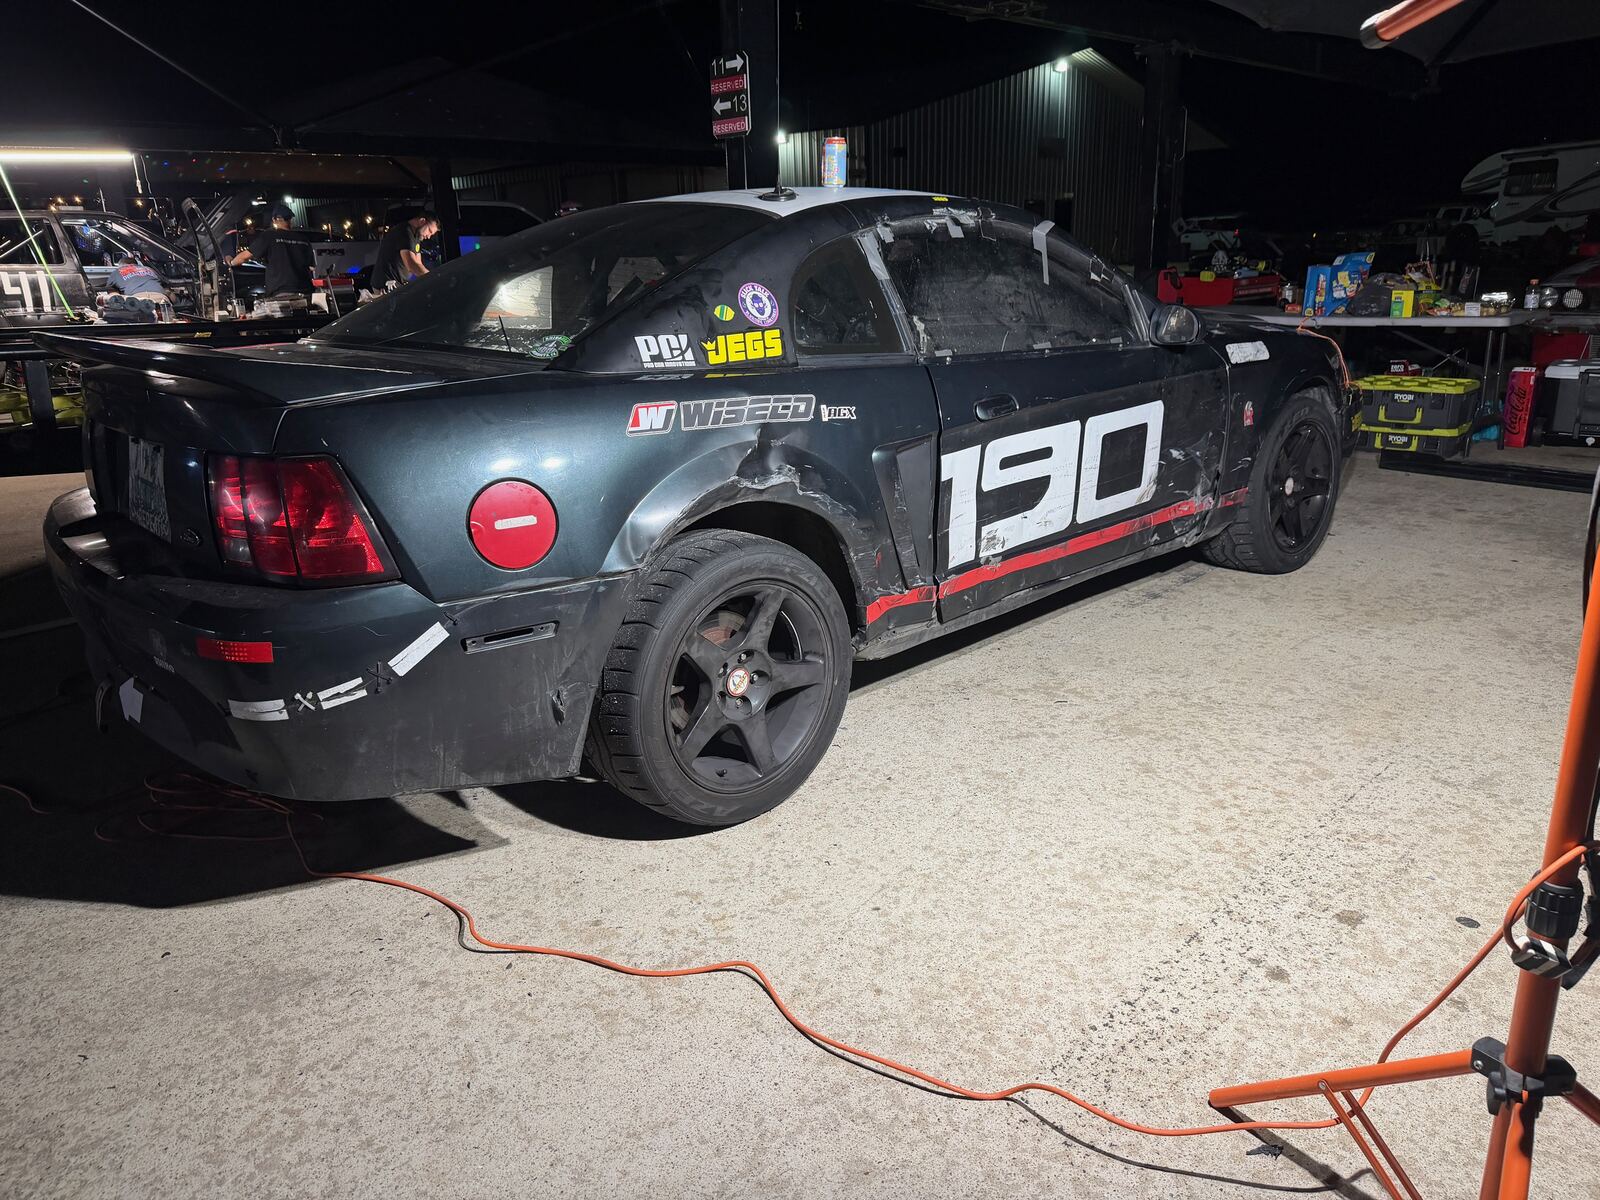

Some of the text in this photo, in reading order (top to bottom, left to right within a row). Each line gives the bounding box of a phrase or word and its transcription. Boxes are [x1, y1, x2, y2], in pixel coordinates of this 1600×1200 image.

[711, 57, 725, 76] 11
[711, 77, 744, 93] RESERVED
[733, 94, 748, 112] 13
[713, 121, 746, 135] RESERVED
[753, 285, 770, 298] TALK
[707, 328, 783, 366] JEGS
[1394, 393, 1414, 401] RYOBI
[1388, 434, 1408, 443] RYOBI
[940, 399, 1165, 570] 190
